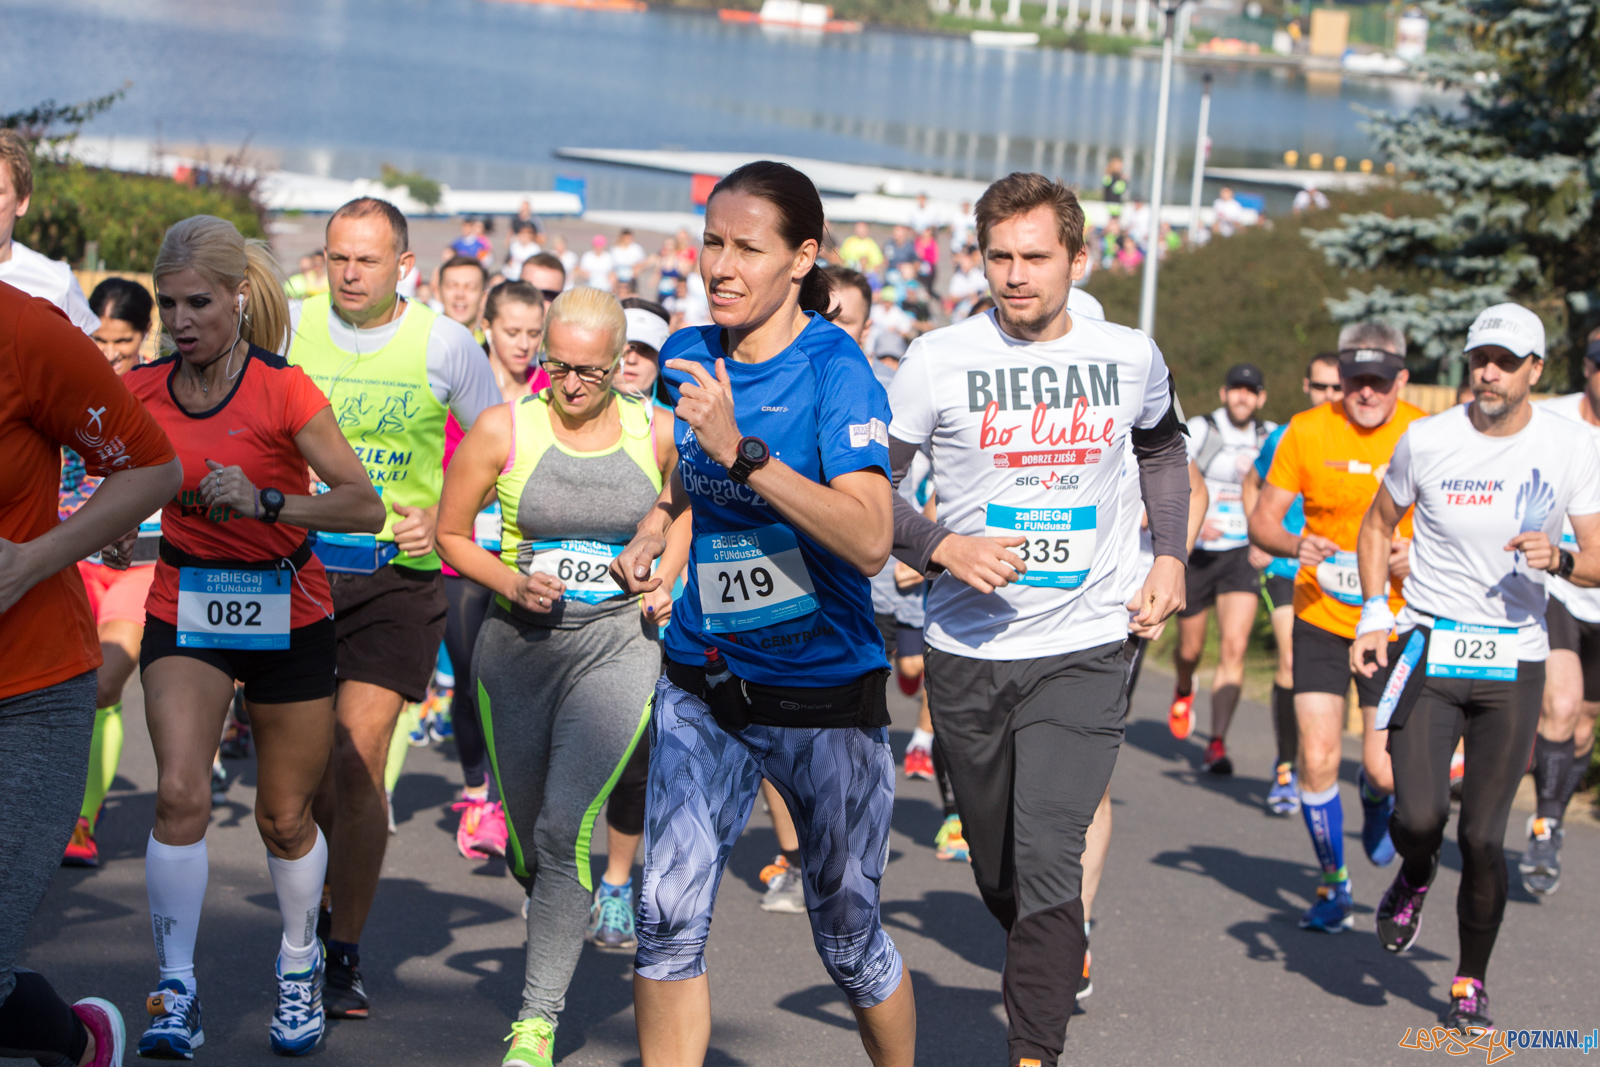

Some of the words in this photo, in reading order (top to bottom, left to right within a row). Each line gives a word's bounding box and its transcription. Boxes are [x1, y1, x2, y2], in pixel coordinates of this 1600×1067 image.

[967, 363, 1119, 412] BIEGAM
[980, 400, 1022, 450] bo
[1031, 396, 1116, 447] lubię
[355, 446, 412, 466] ZIEMI
[1022, 454, 1052, 465] DOBRZE
[1053, 451, 1076, 463] ZJEŚĆ
[369, 469, 408, 481] SKIEJ
[1441, 479, 1505, 491] HERNIK
[1446, 493, 1493, 505] TEAM
[1015, 510, 1072, 523] zaBIEGaj
[1023, 521, 1072, 530] FUNdusze
[712, 532, 759, 549] zaBIEGaj
[720, 548, 763, 560] FUNdusze
[1020, 538, 1069, 563] 335
[207, 572, 262, 585] zaBIEGaj
[557, 558, 609, 583] 682
[718, 567, 774, 603] 219
[1336, 571, 1358, 588] 16
[215, 584, 262, 593] FUNdusze
[207, 600, 262, 626] 082
[760, 625, 835, 649] CENTRUM
[1454, 639, 1497, 660] 023
